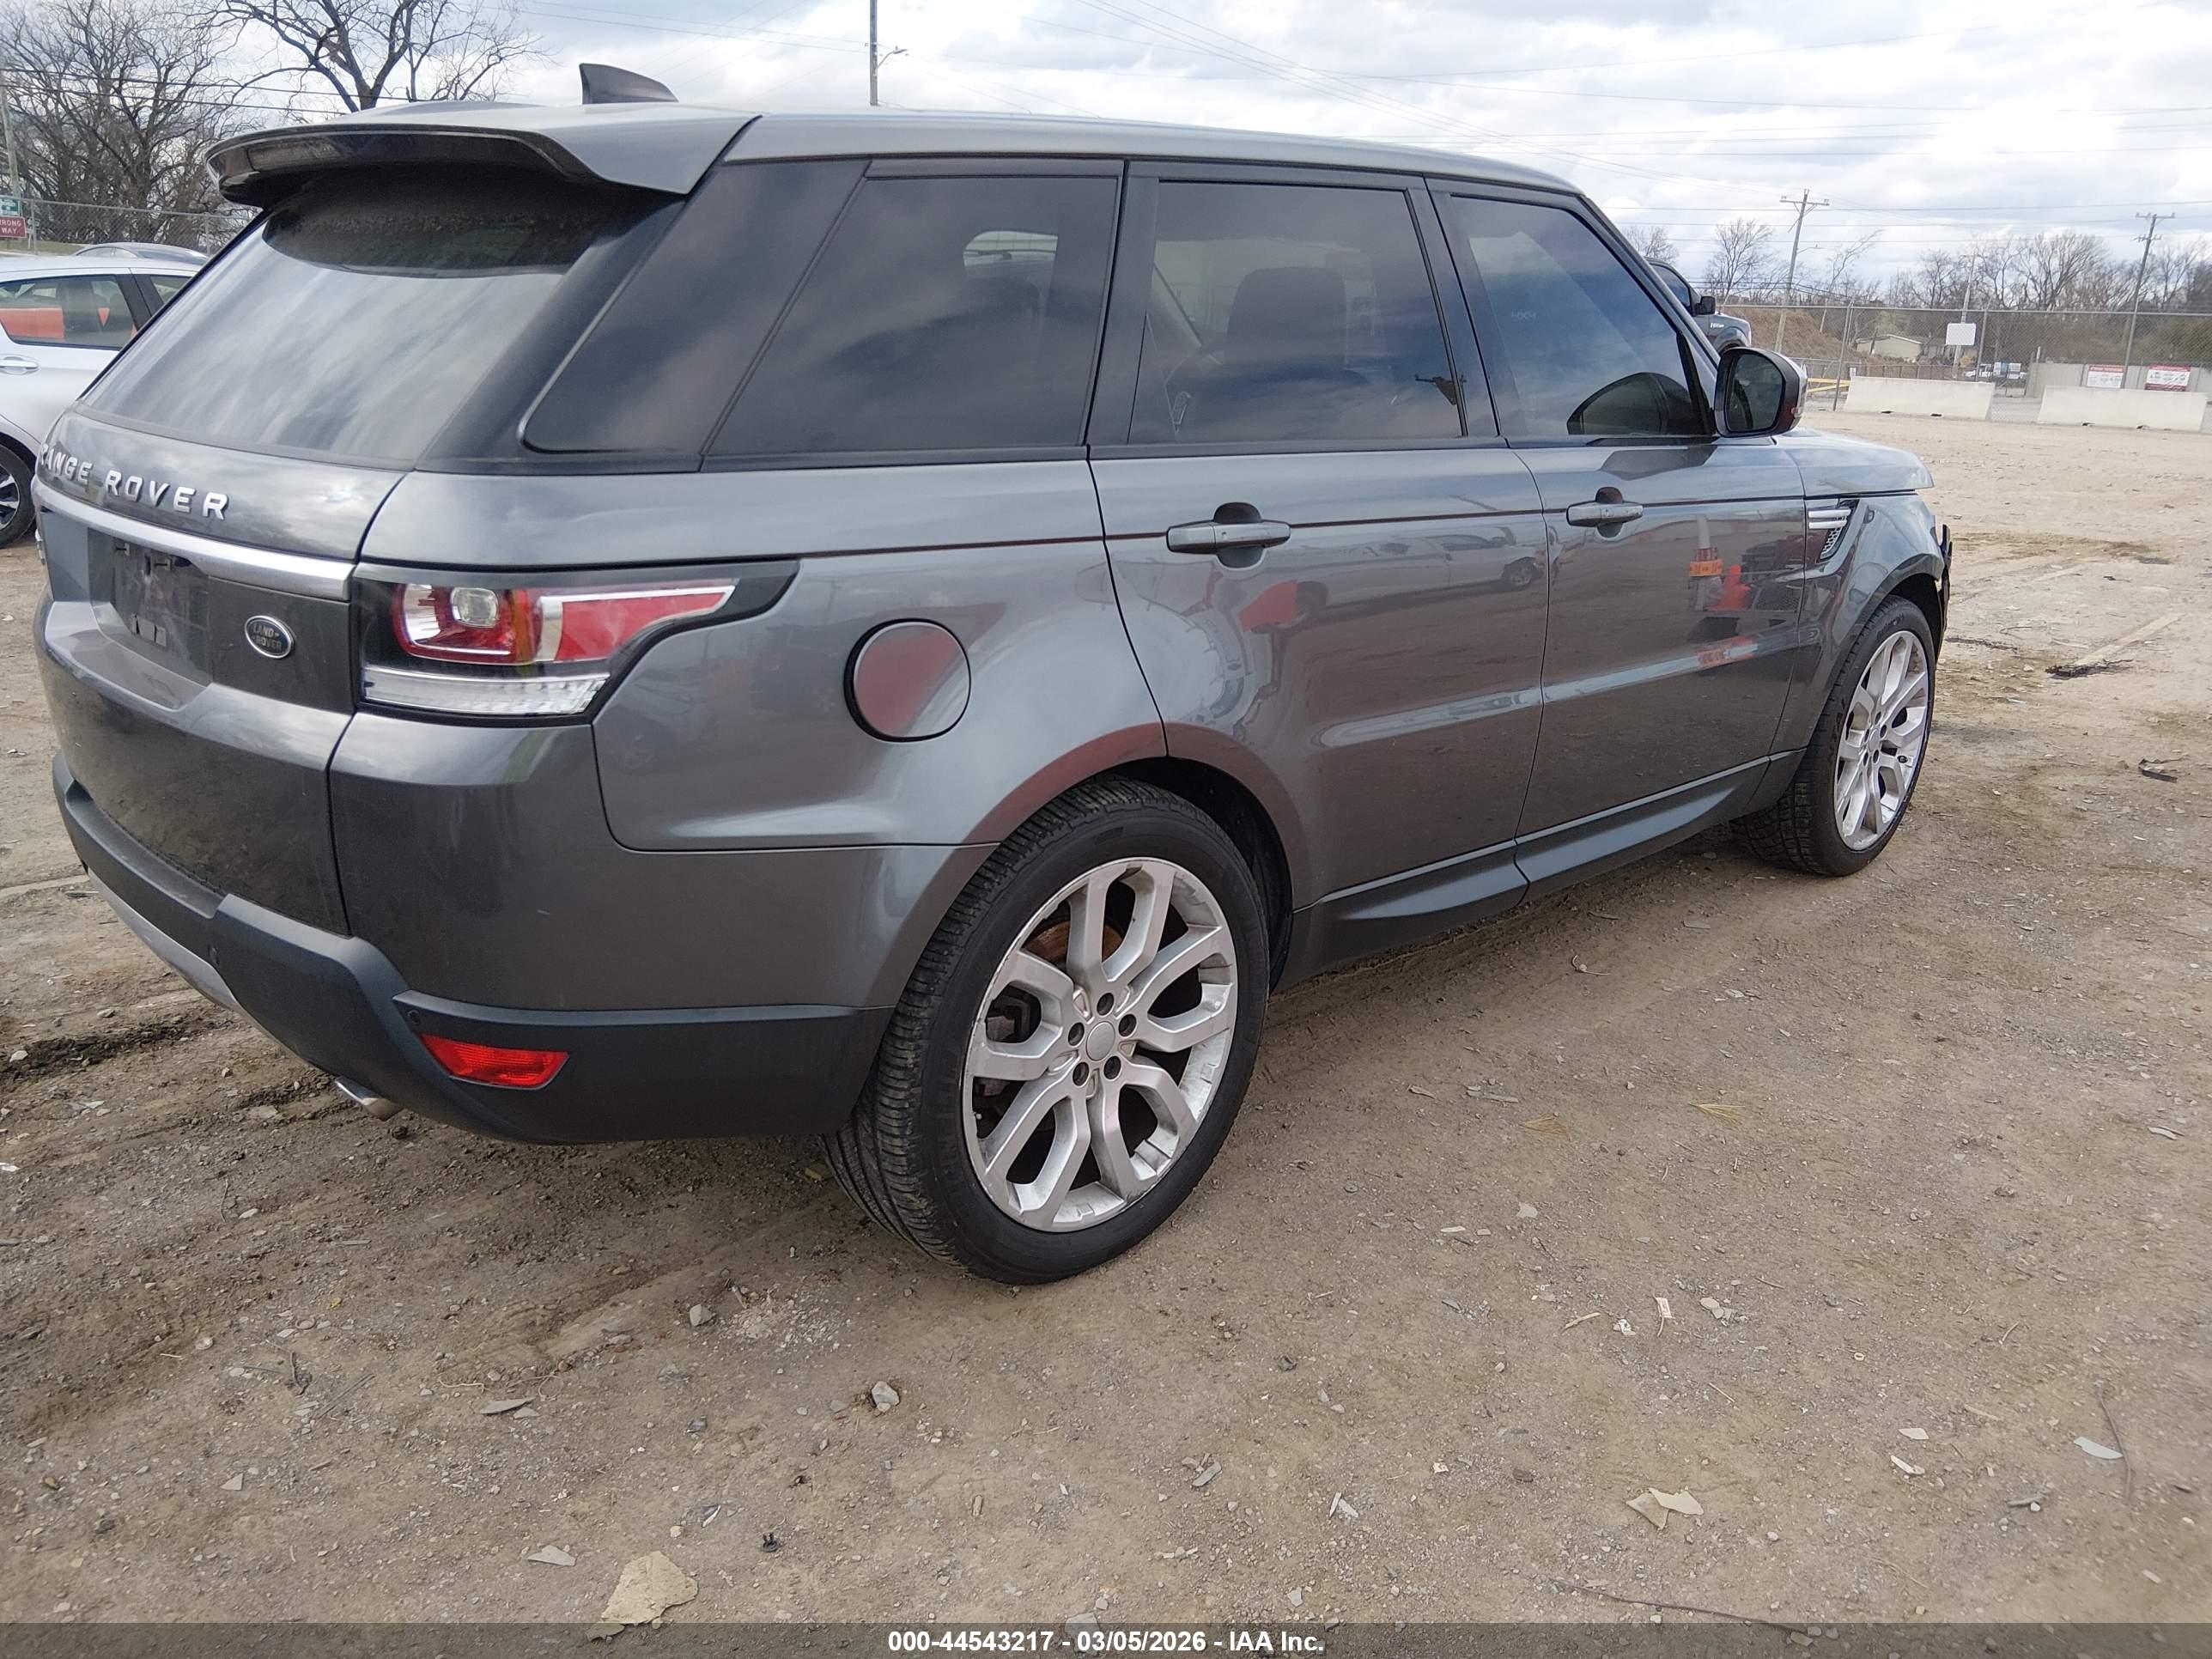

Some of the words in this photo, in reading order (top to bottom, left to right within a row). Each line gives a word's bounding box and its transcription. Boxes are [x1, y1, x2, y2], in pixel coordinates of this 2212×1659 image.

[39, 443, 93, 483] RANGE
[105, 470, 229, 520] ROVER
[253, 623, 275, 638] LAND
[255, 635, 283, 651] ROVER
